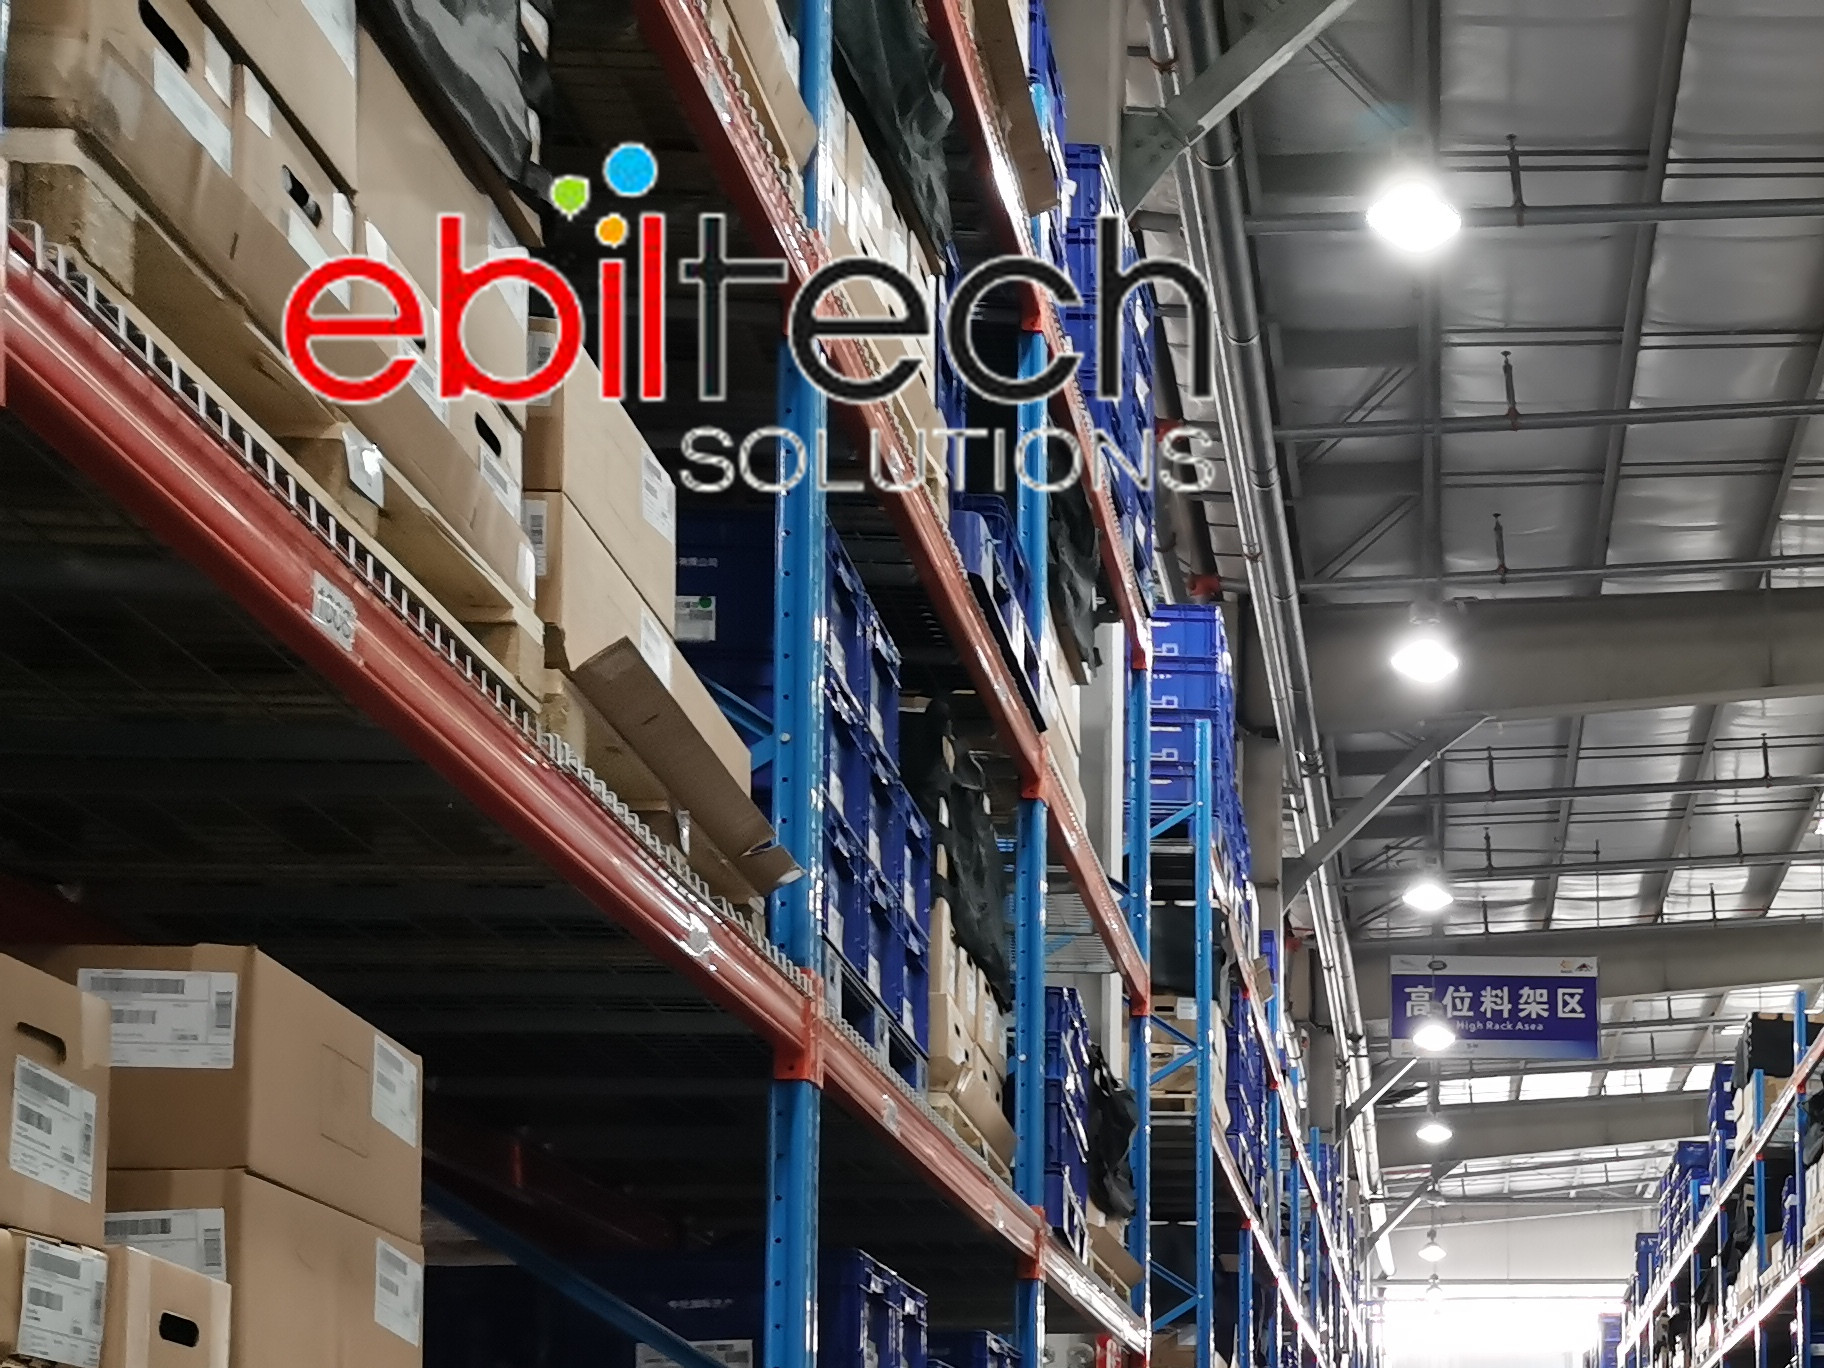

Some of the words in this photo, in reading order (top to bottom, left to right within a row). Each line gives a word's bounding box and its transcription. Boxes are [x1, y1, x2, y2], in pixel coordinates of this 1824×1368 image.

[1404, 984, 1586, 1020] 高位料架区
[1456, 1020, 1484, 1033] High
[1485, 1020, 1513, 1031] Rack
